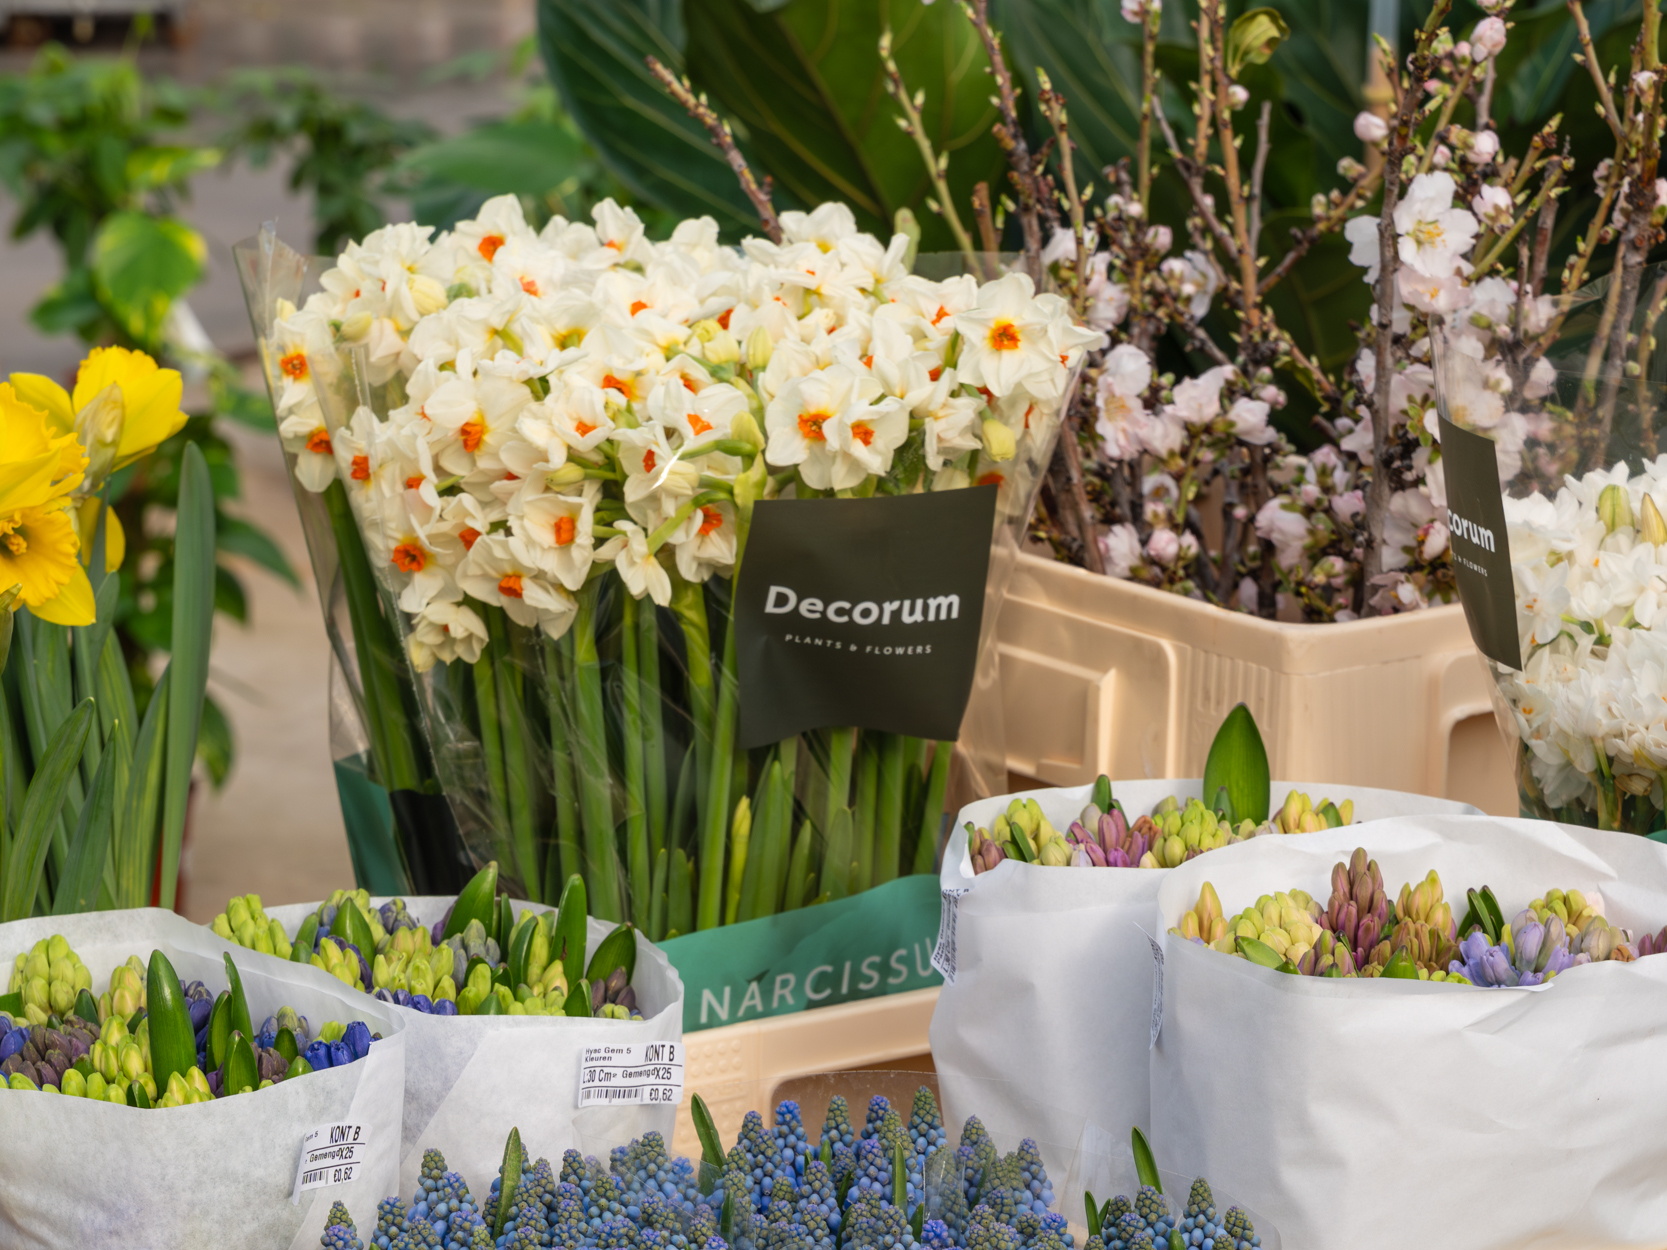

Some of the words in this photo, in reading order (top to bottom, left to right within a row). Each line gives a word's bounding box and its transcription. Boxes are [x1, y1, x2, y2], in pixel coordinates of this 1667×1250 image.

[1447, 508, 1496, 553] corum
[764, 585, 960, 625] Decorum
[785, 633, 843, 650] PLANTS
[865, 644, 932, 656] FLOWERS
[700, 937, 933, 1024] NARCISSU
[585, 1055, 612, 1063] Kleuren
[644, 1044, 665, 1062] KONT
[668, 1045, 675, 1062] B
[649, 1088, 673, 1104] €0,62
[329, 1125, 352, 1144] KONT
[353, 1126, 361, 1141] B
[333, 1166, 353, 1183] €0,62
